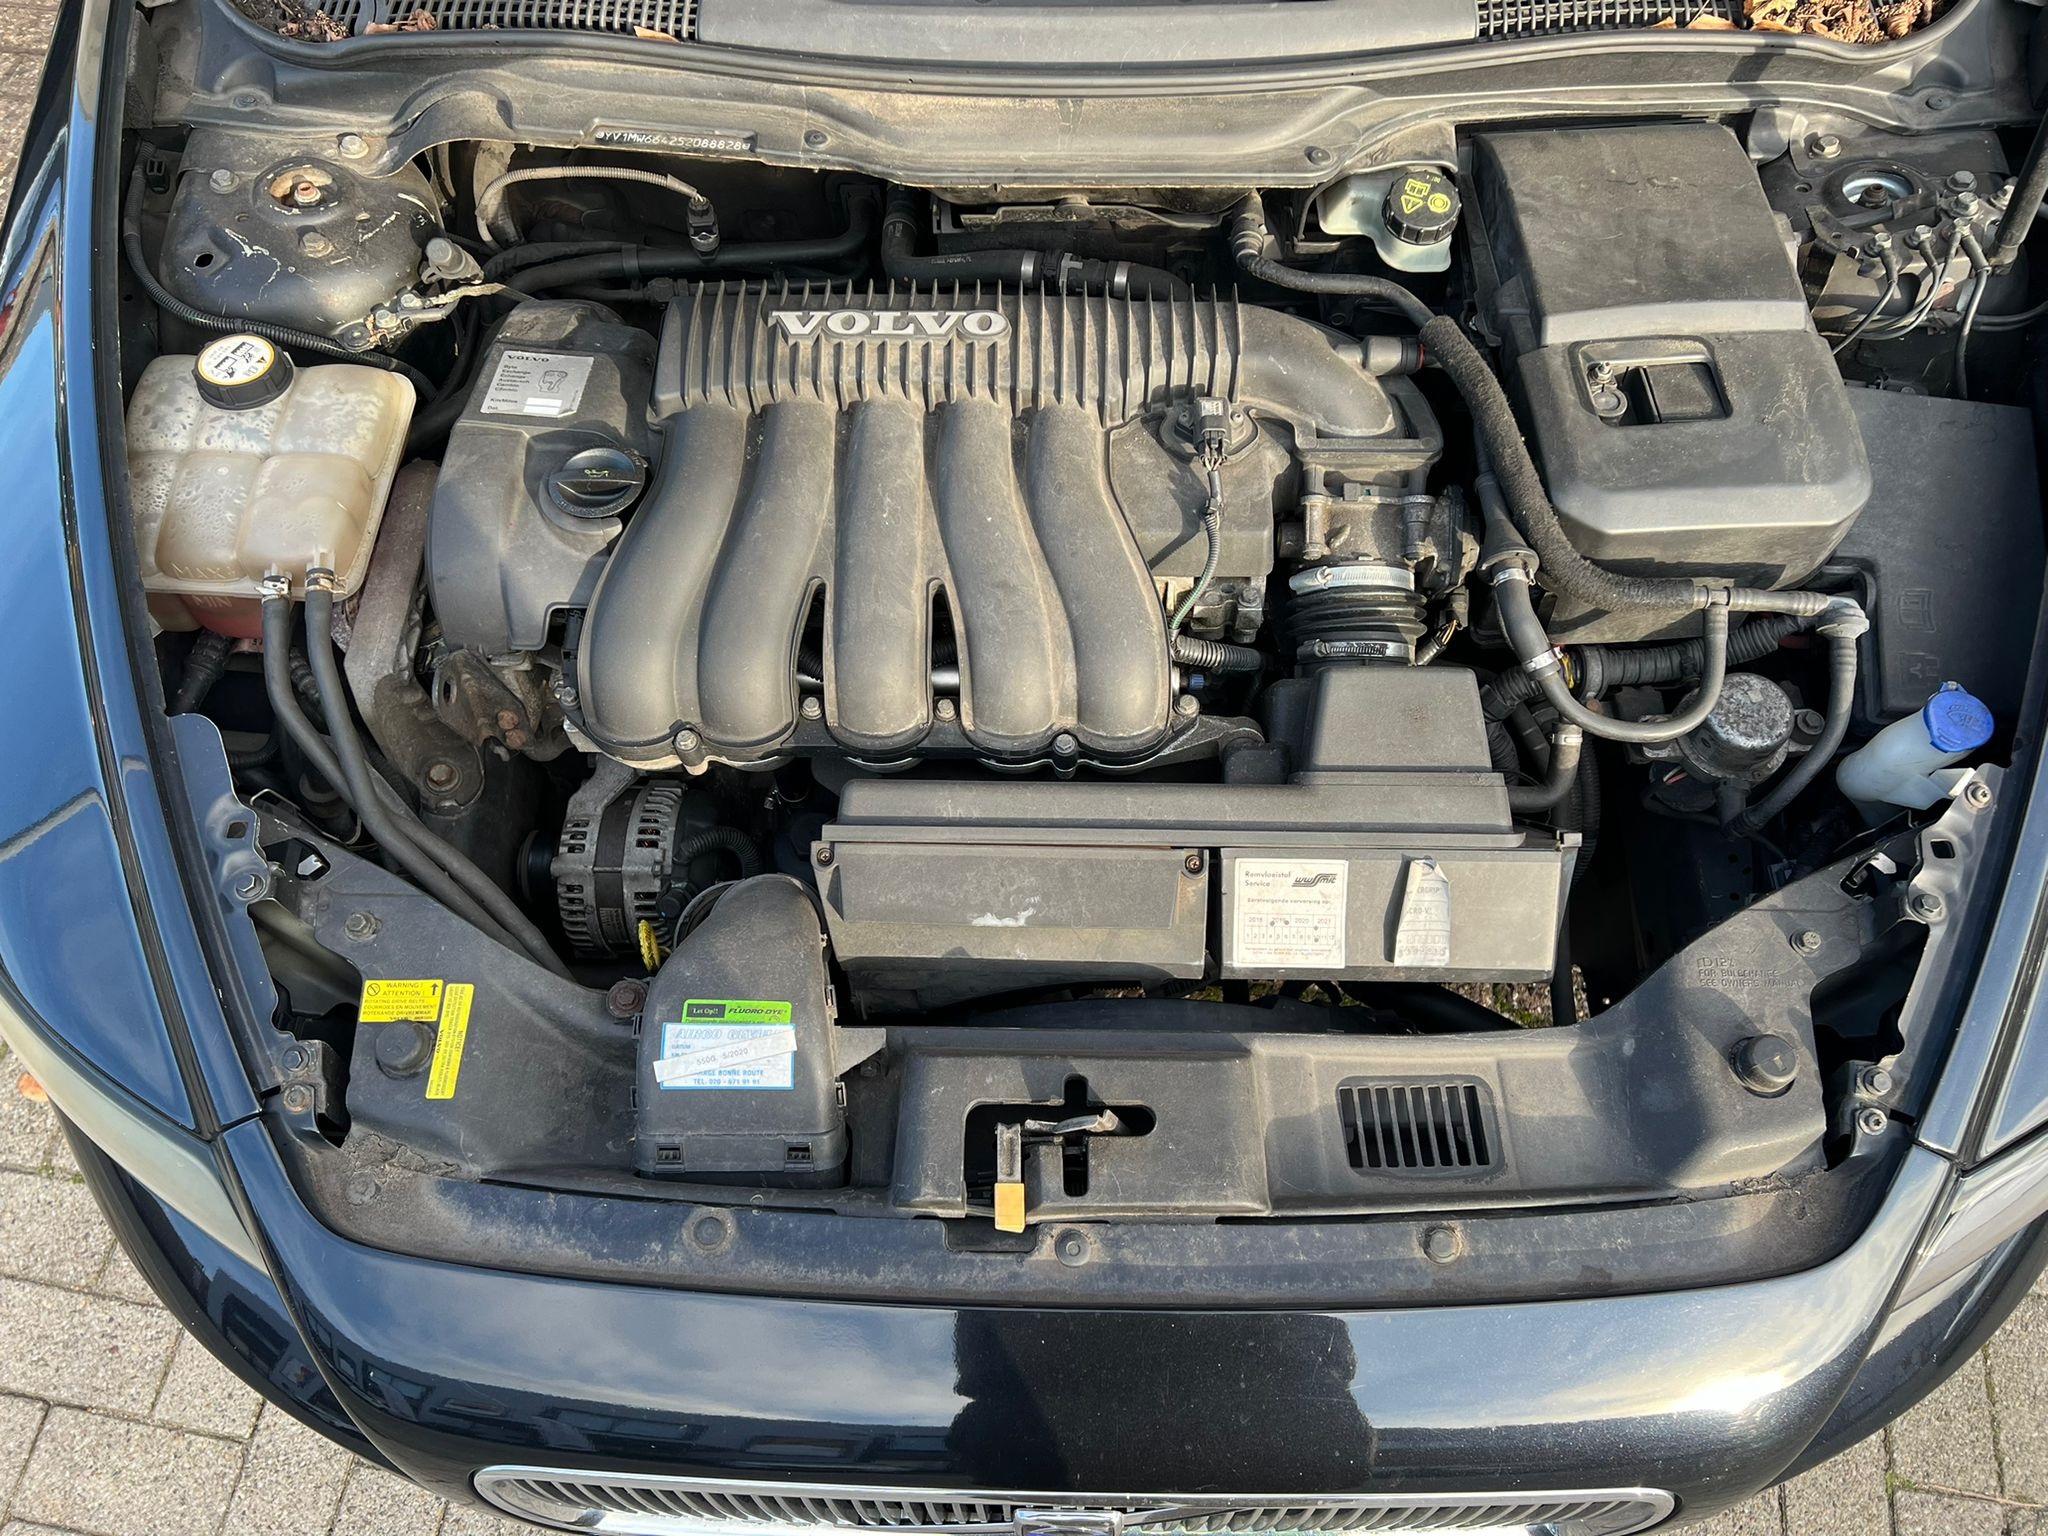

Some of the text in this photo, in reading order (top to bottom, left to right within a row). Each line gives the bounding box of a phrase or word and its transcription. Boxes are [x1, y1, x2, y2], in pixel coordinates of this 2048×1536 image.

[769, 311, 1008, 337] VOLVO
[507, 354, 550, 363] VOLVO
[191, 594, 233, 608] MIN
[1244, 879, 1271, 888] Service
[1699, 978, 1717, 987] SEE
[436, 1029, 445, 1054] VOLVO
